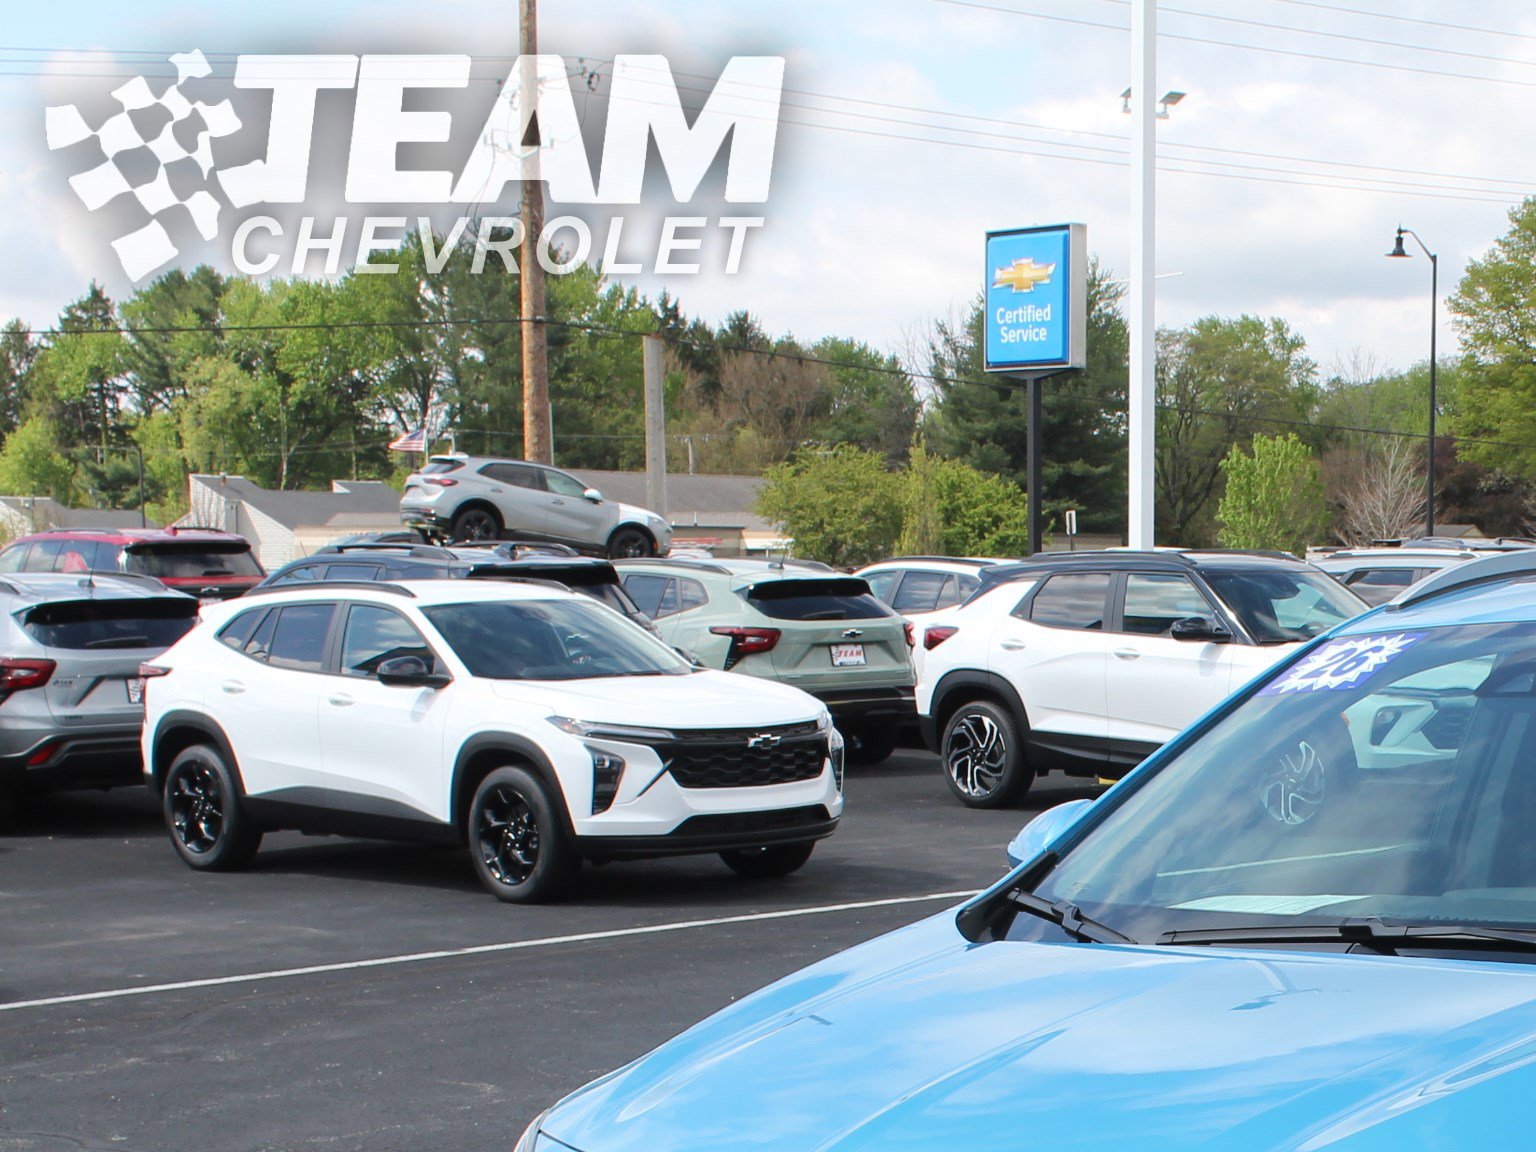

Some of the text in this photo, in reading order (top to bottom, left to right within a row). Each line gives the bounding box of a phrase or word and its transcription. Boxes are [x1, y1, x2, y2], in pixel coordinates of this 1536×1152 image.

[996, 304, 1051, 324] Certified
[1000, 325, 1048, 343] Service
[1298, 645, 1385, 677] 26
